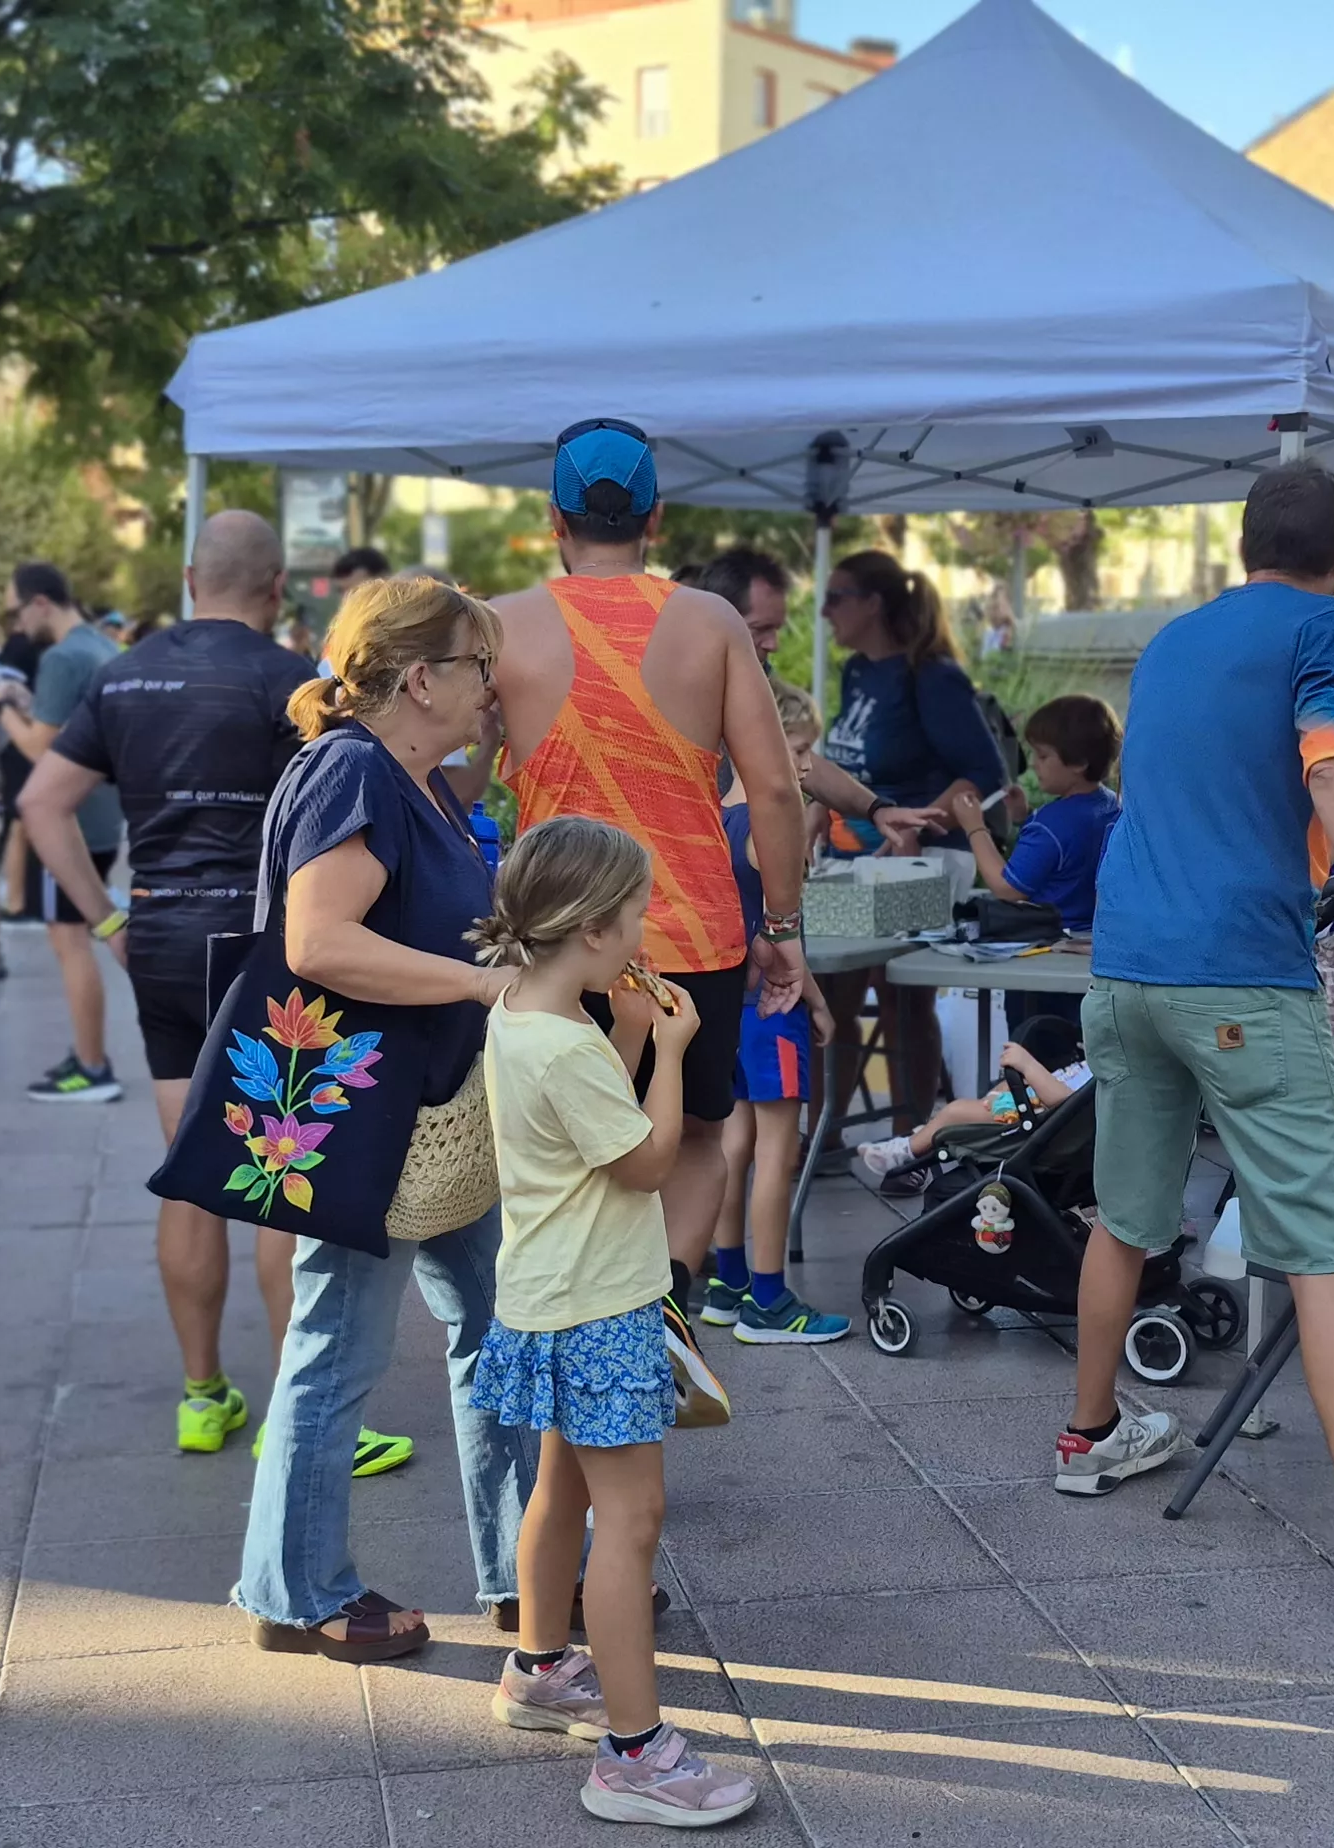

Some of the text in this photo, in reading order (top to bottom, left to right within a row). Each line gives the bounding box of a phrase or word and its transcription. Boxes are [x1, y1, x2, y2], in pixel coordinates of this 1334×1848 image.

[195, 790, 216, 803] que
[217, 790, 266, 802] mañana
[183, 888, 227, 898] ALFONSO
